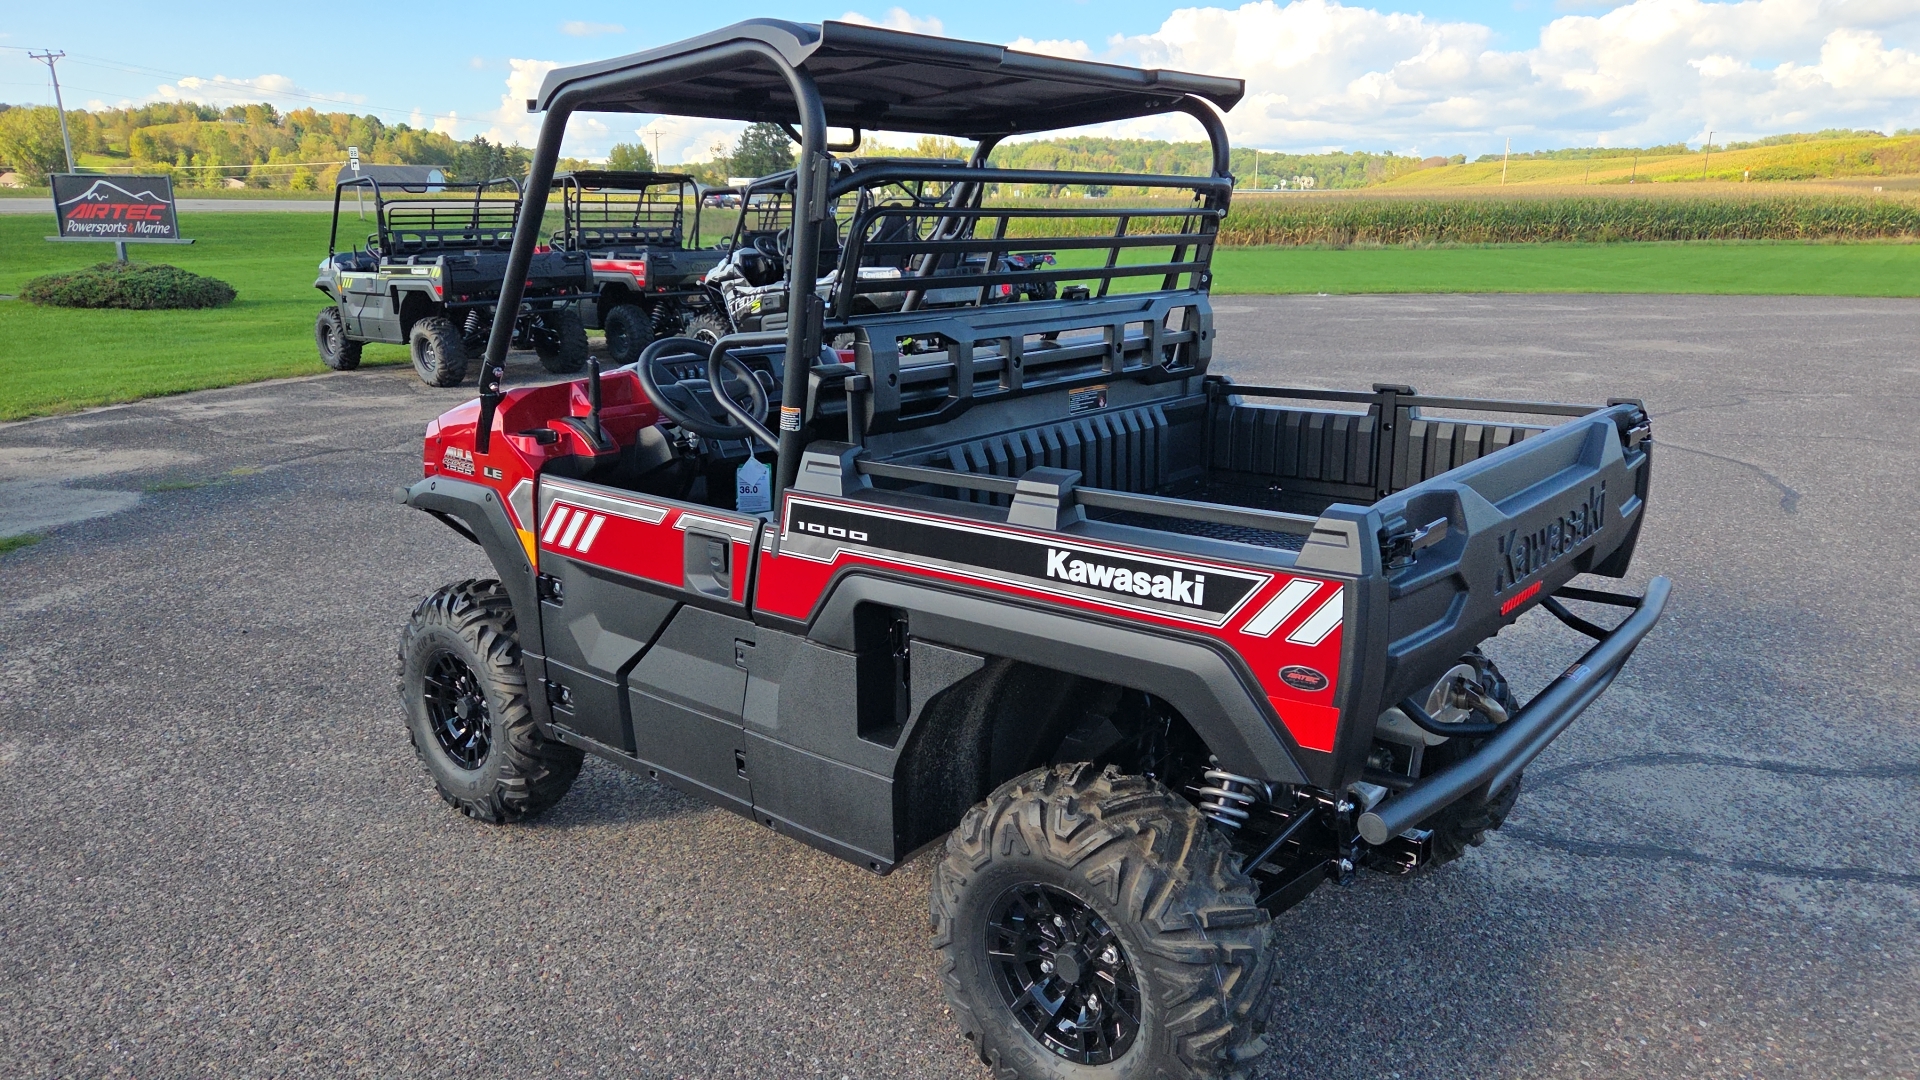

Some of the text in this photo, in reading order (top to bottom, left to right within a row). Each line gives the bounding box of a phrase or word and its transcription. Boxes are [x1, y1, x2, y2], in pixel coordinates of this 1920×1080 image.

[66, 203, 166, 220] AIRTEC
[67, 219, 170, 235] Powersports & Marine
[483, 466, 503, 480] LE
[739, 486, 758, 494] 36.0
[798, 521, 868, 542] 1000
[1494, 480, 1607, 596] Kawasaki
[1046, 548, 1206, 606] Kawasaki
